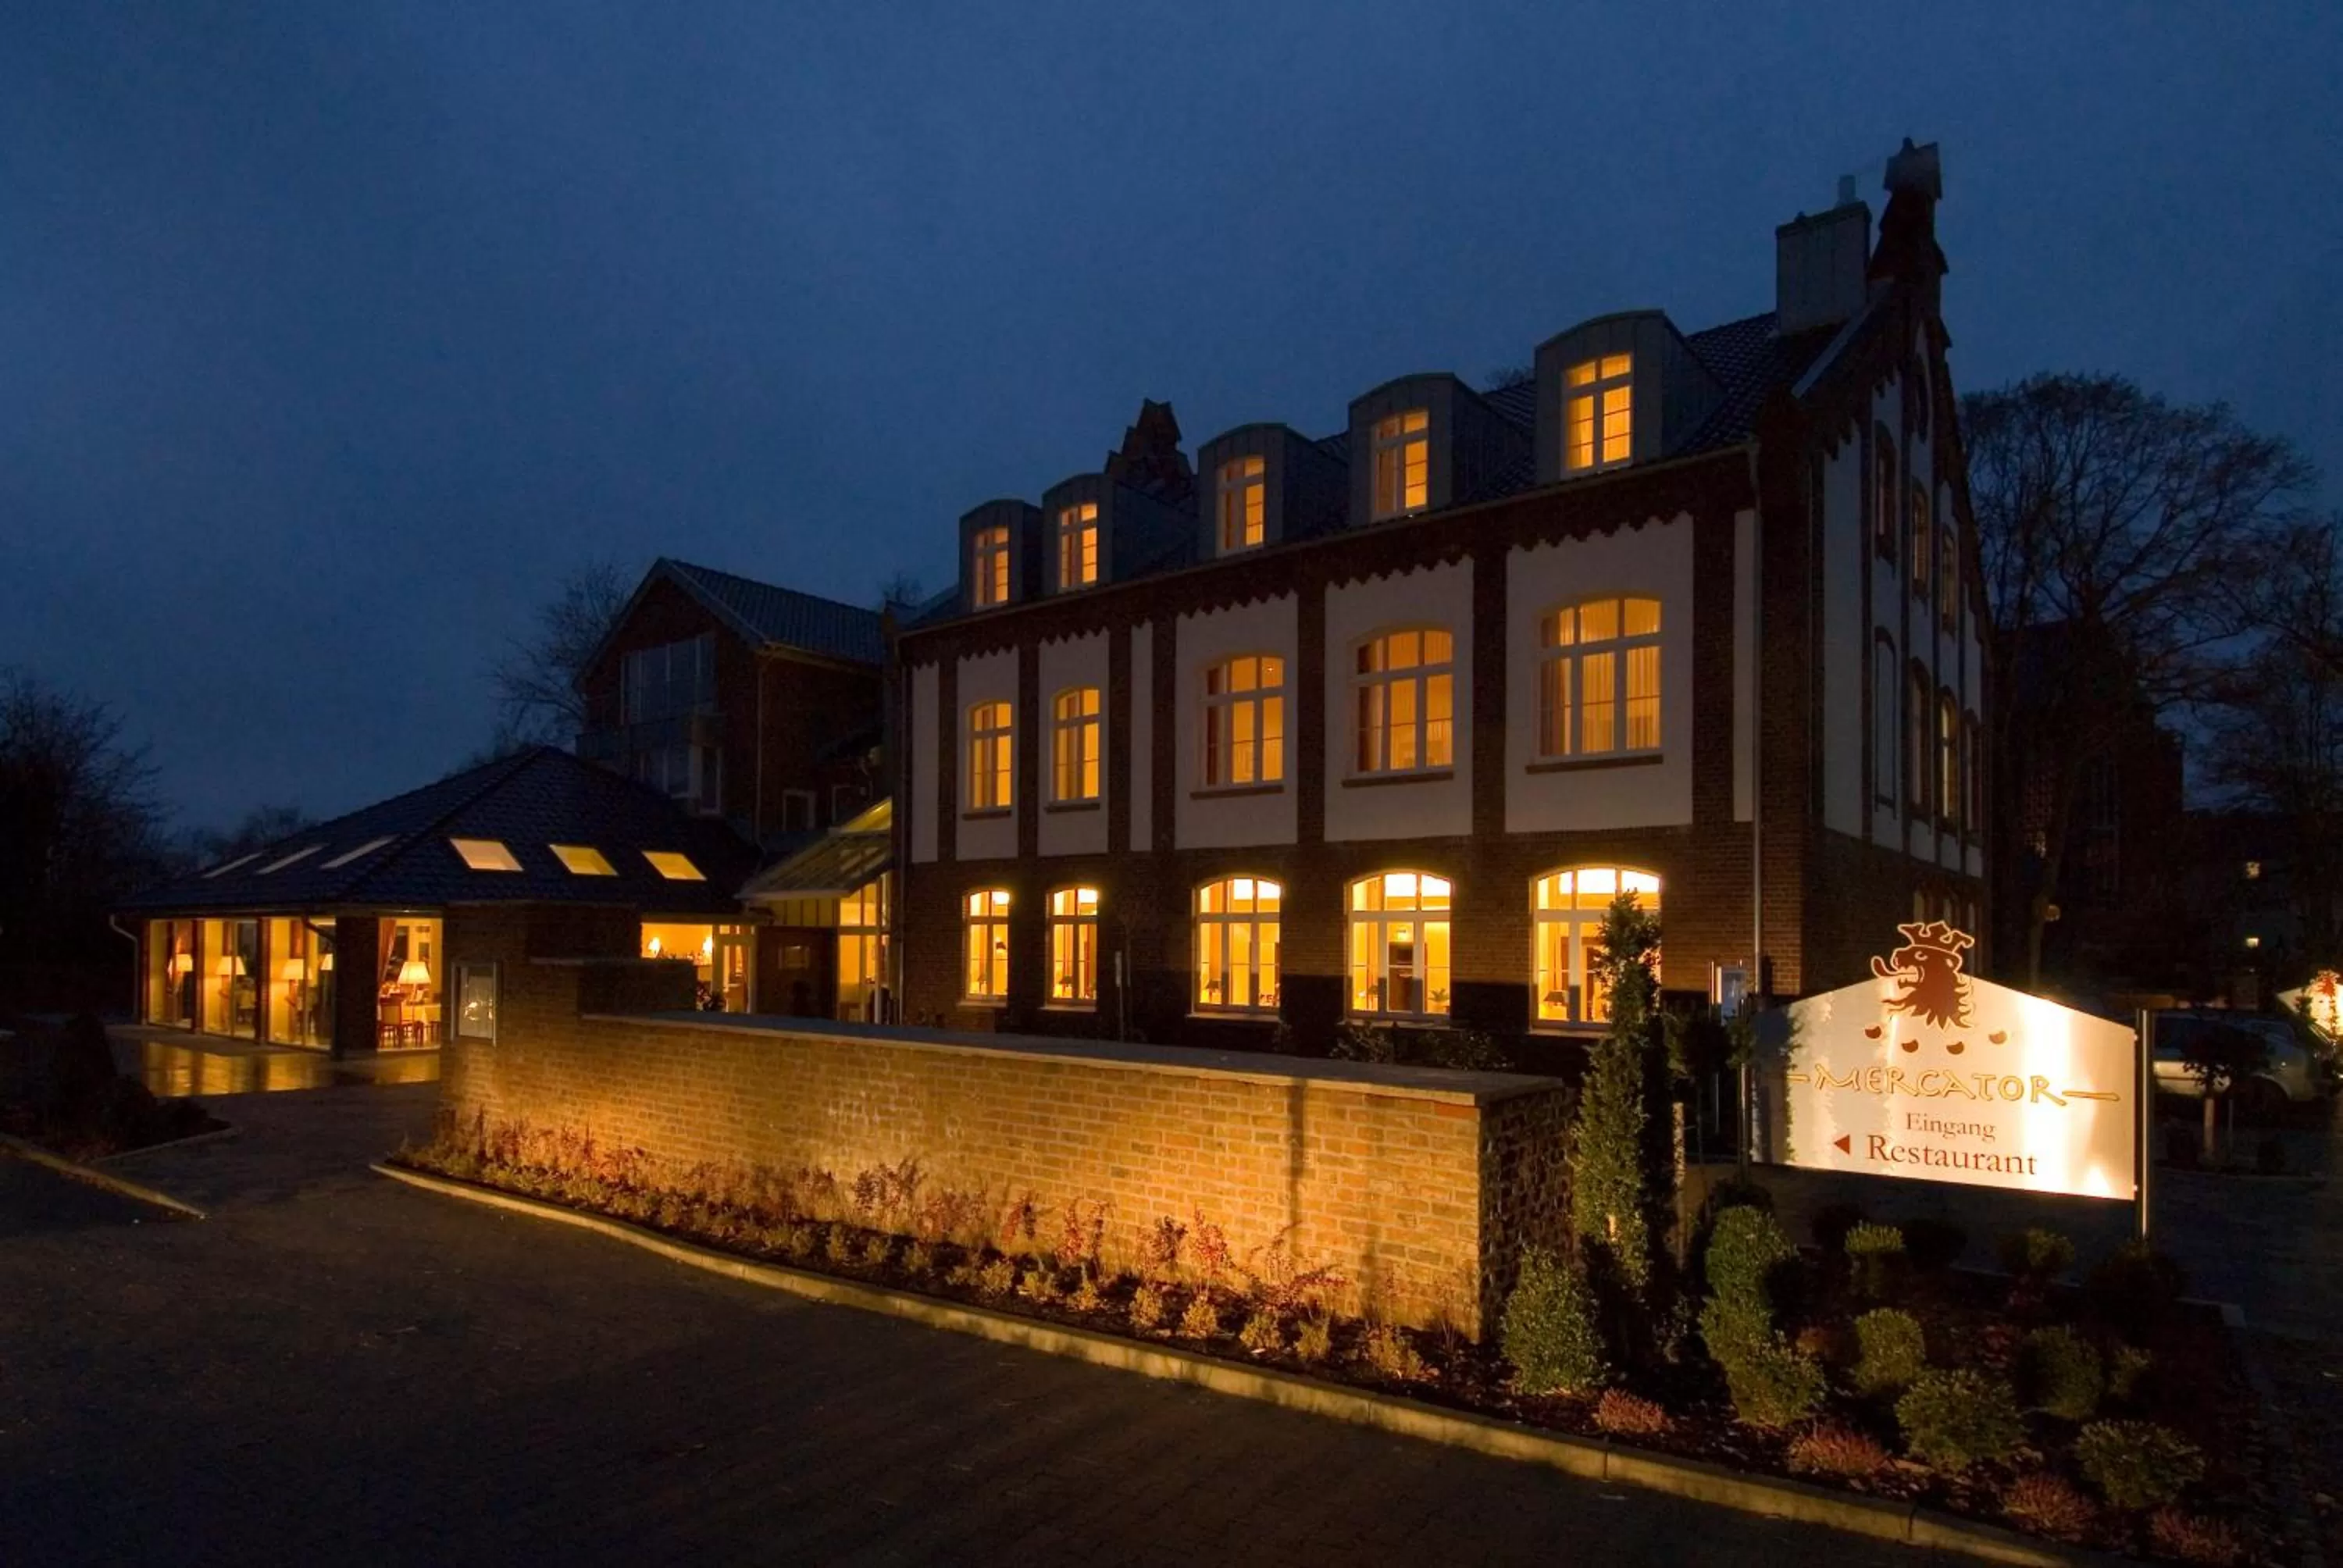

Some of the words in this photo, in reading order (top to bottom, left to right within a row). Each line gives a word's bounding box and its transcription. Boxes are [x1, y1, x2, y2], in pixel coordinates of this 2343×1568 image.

[1813, 1063, 2067, 1107] MERCATOR
[1906, 1112, 1996, 1142] Eingang
[1866, 1135, 2038, 1175] Restaurant
